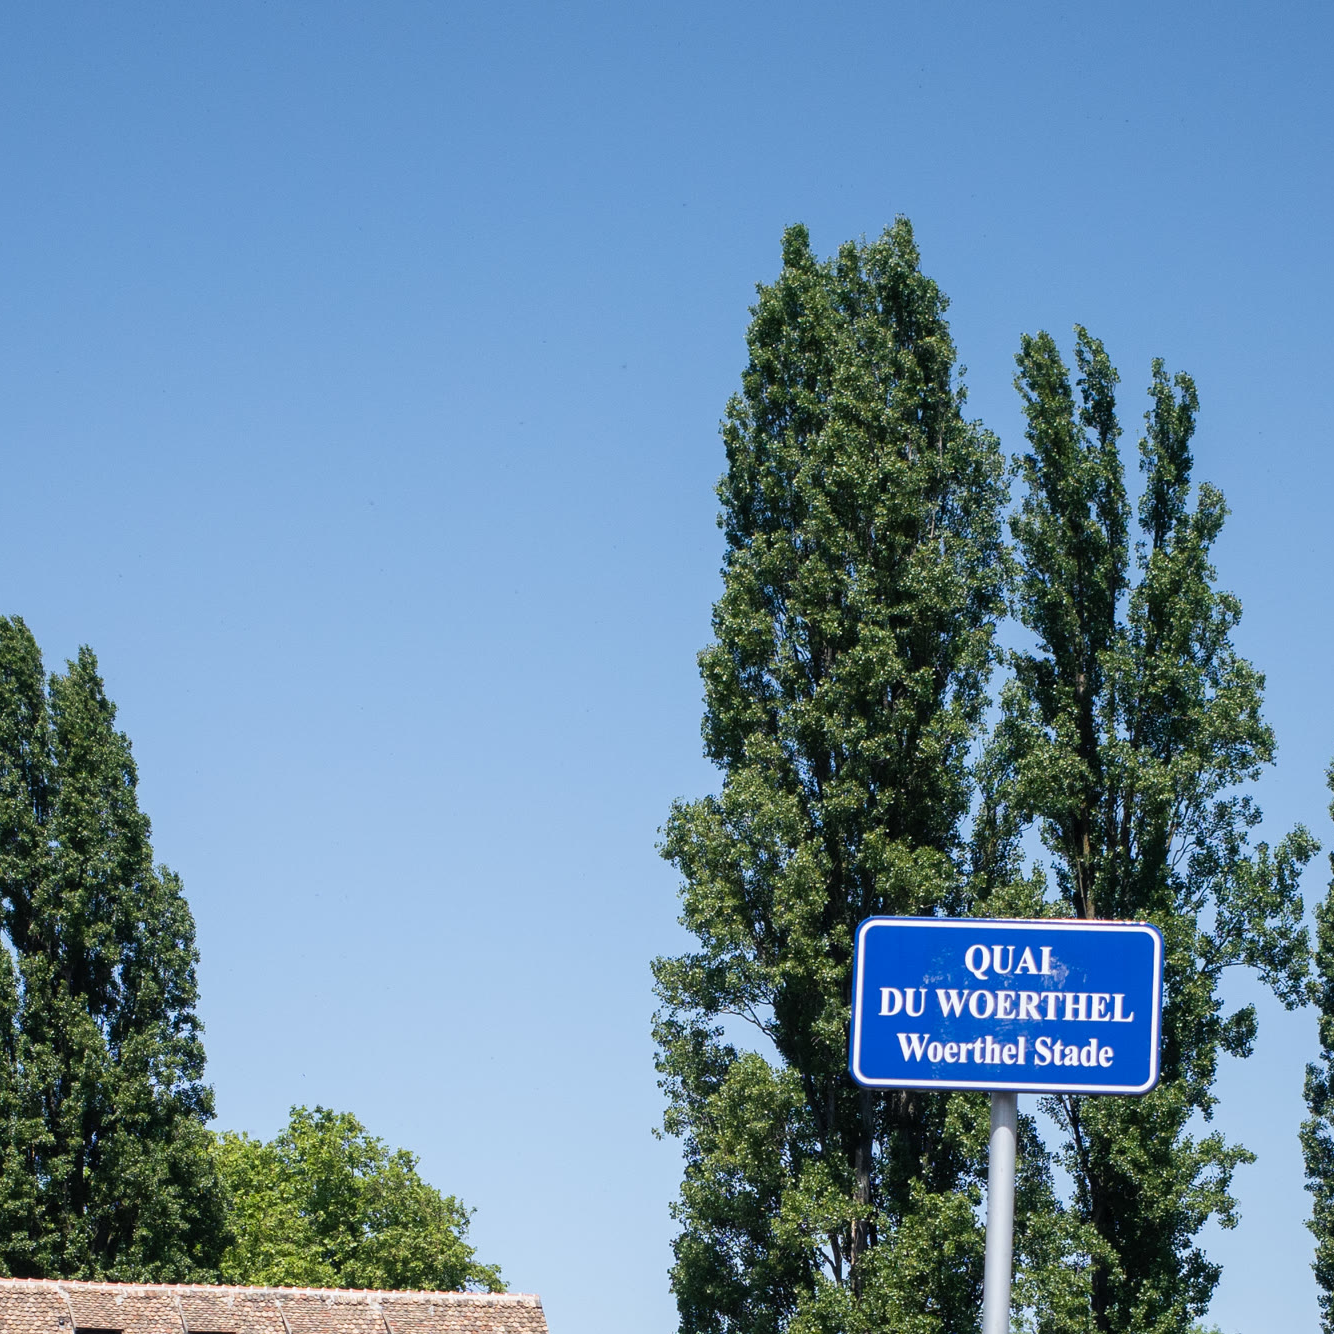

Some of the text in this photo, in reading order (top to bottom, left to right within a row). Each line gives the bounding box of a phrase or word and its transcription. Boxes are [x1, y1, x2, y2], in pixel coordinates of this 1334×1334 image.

[964, 944, 1053, 980] QUAI
[878, 987, 1135, 1023] DU WOERTHEL
[896, 1033, 1114, 1067] Woerthel Stade
